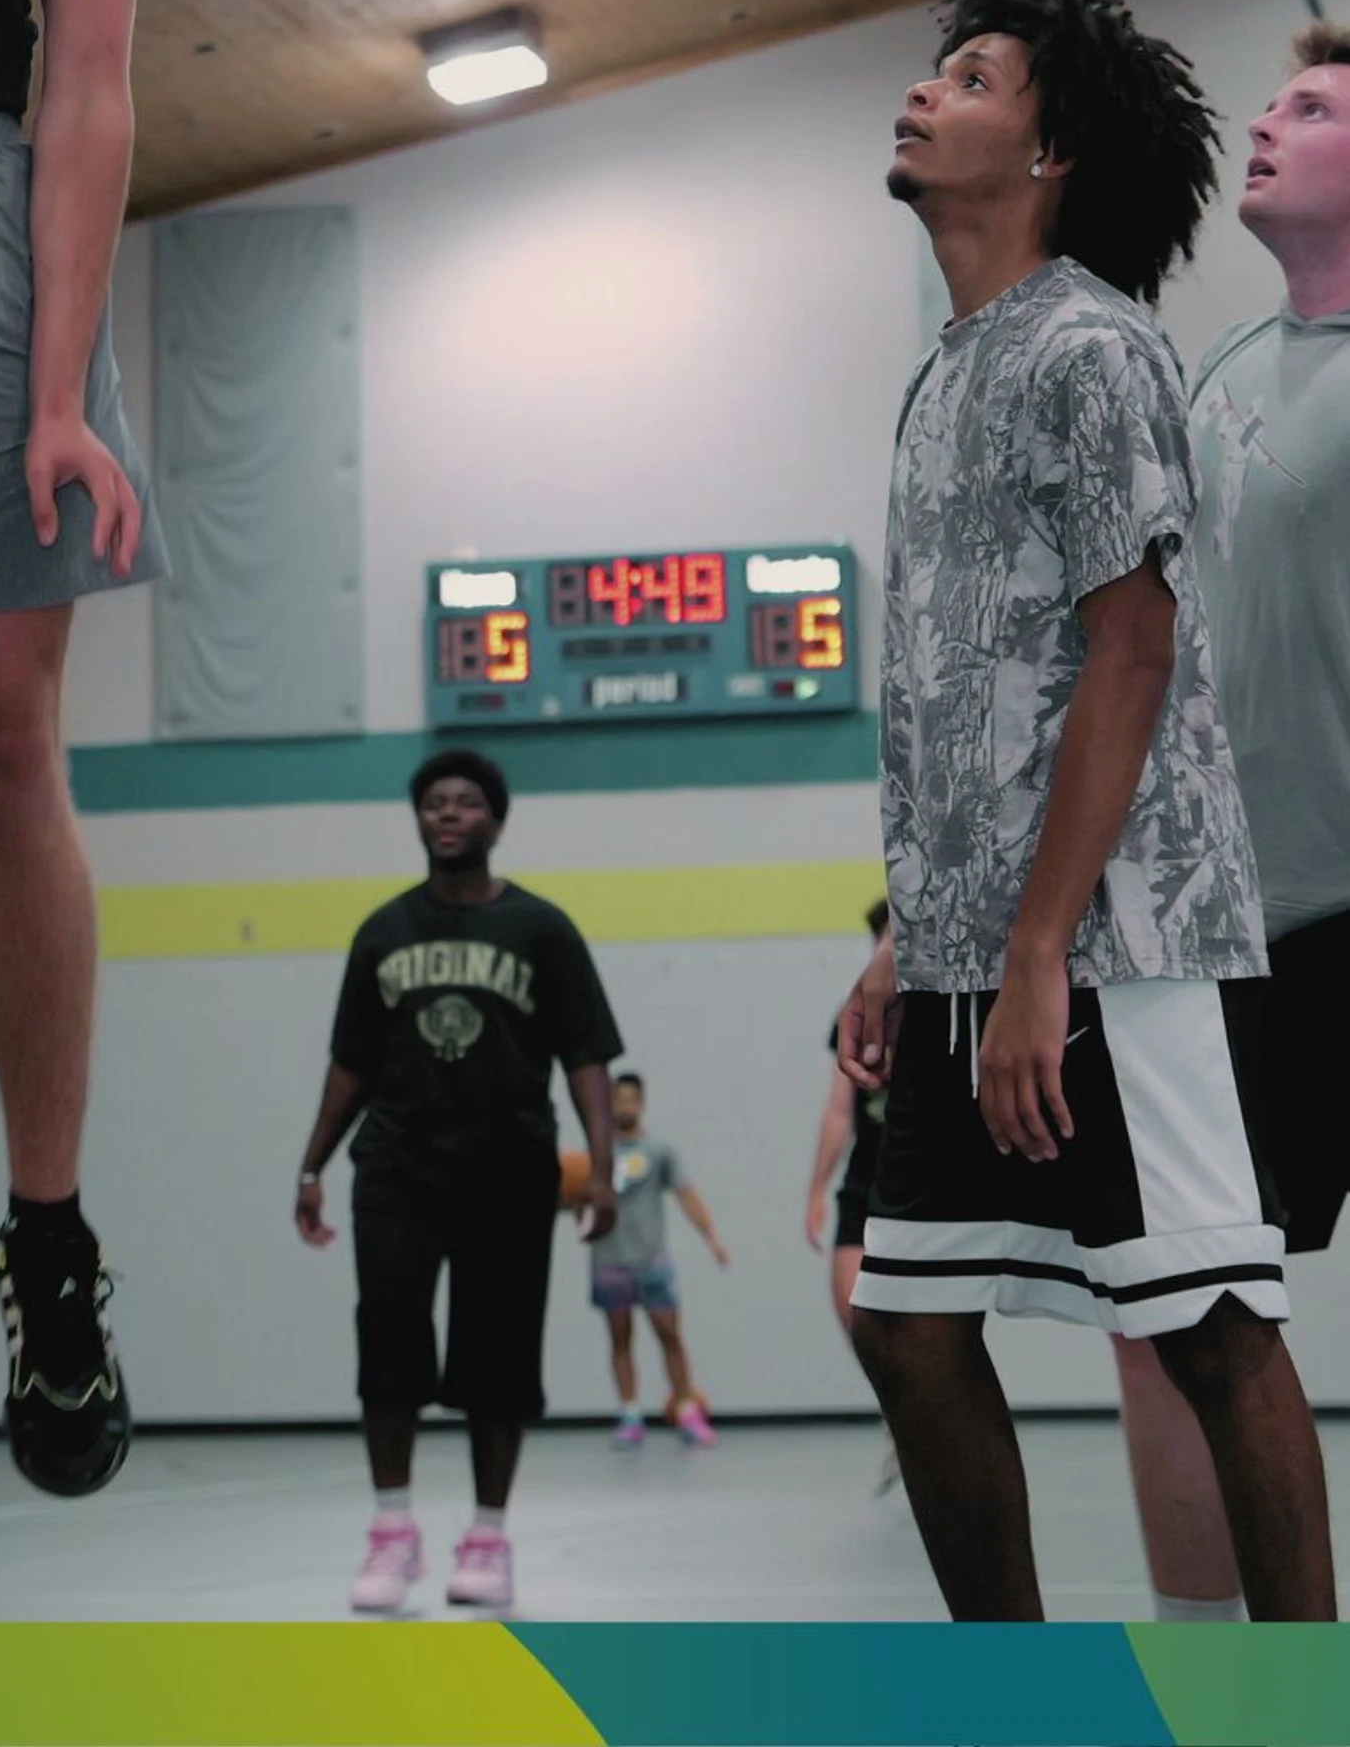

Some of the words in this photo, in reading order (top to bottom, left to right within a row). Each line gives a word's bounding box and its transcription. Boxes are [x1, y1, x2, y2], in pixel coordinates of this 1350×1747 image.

[588, 554, 725, 625] 4:49
[484, 611, 530, 683] 5
[797, 596, 845, 669] 5
